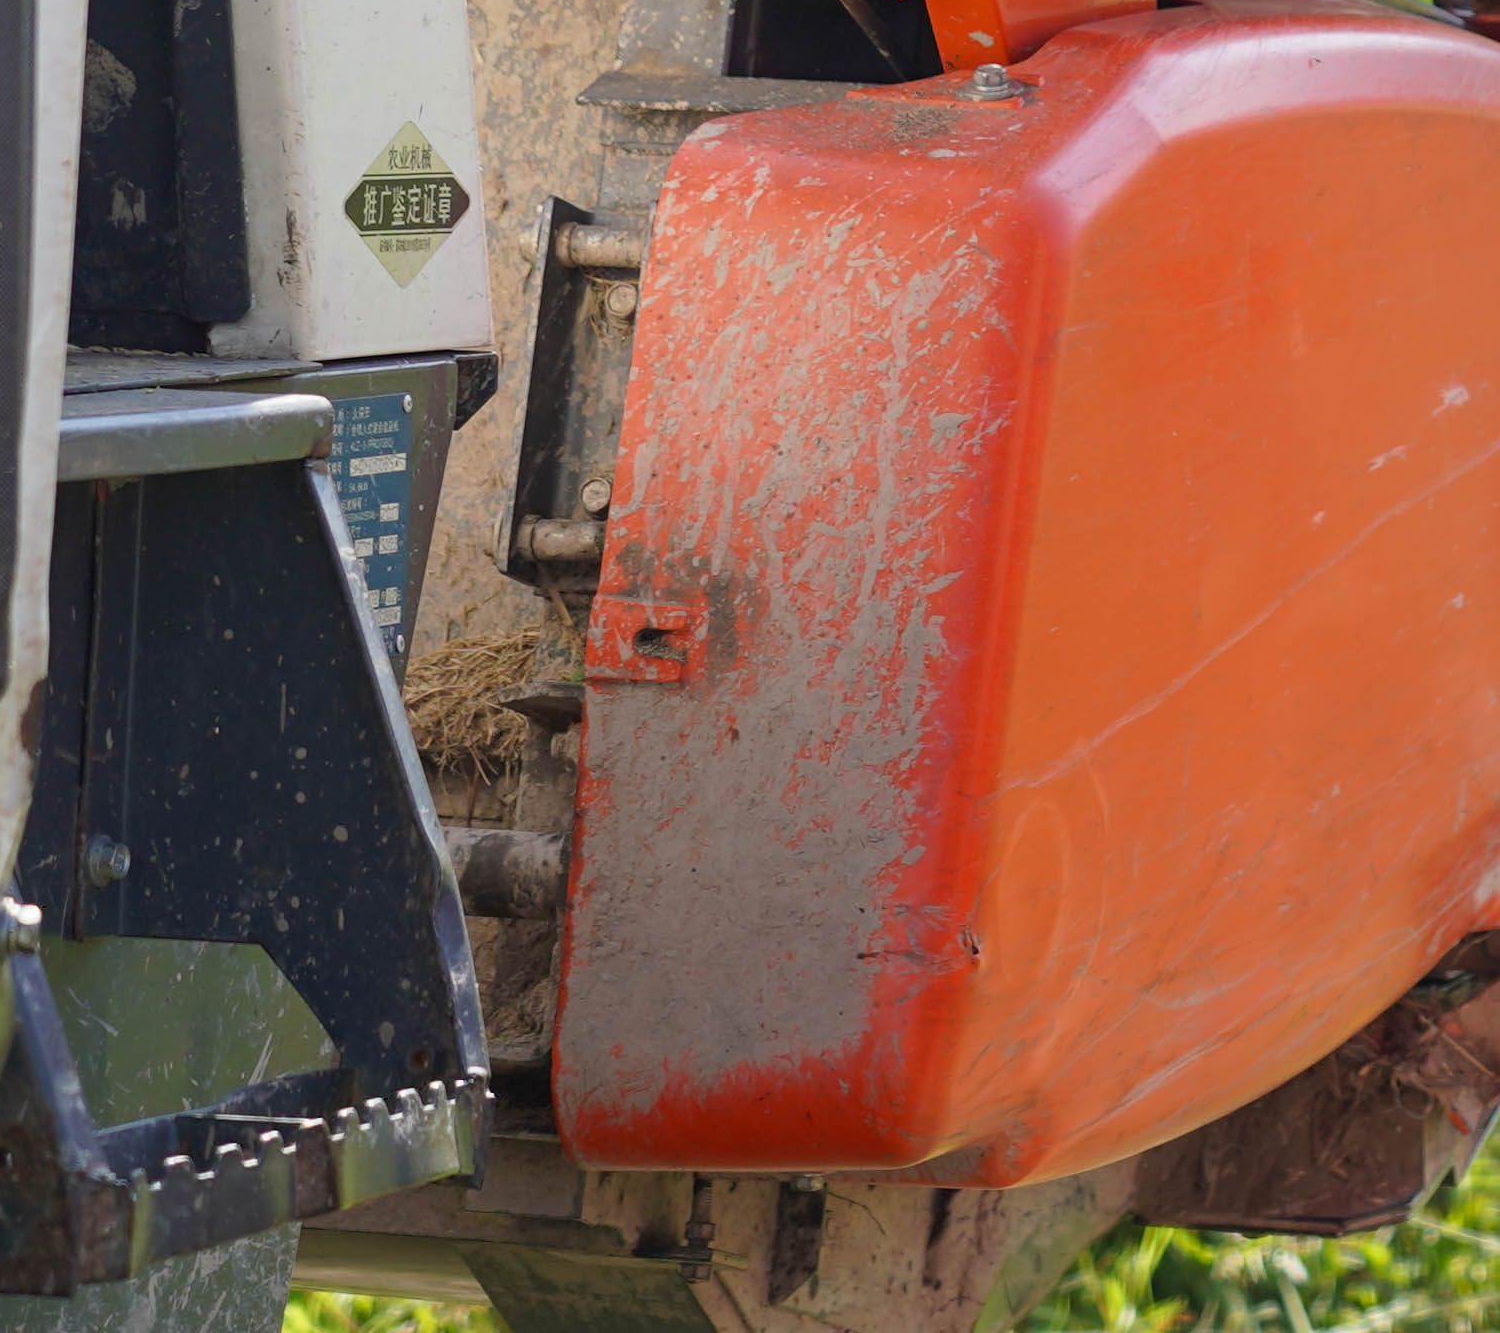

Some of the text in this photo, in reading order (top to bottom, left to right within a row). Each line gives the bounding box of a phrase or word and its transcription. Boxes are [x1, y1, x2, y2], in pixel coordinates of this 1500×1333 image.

[388, 143, 433, 171] 农业机械
[363, 183, 453, 226] 推广鉴定证章
